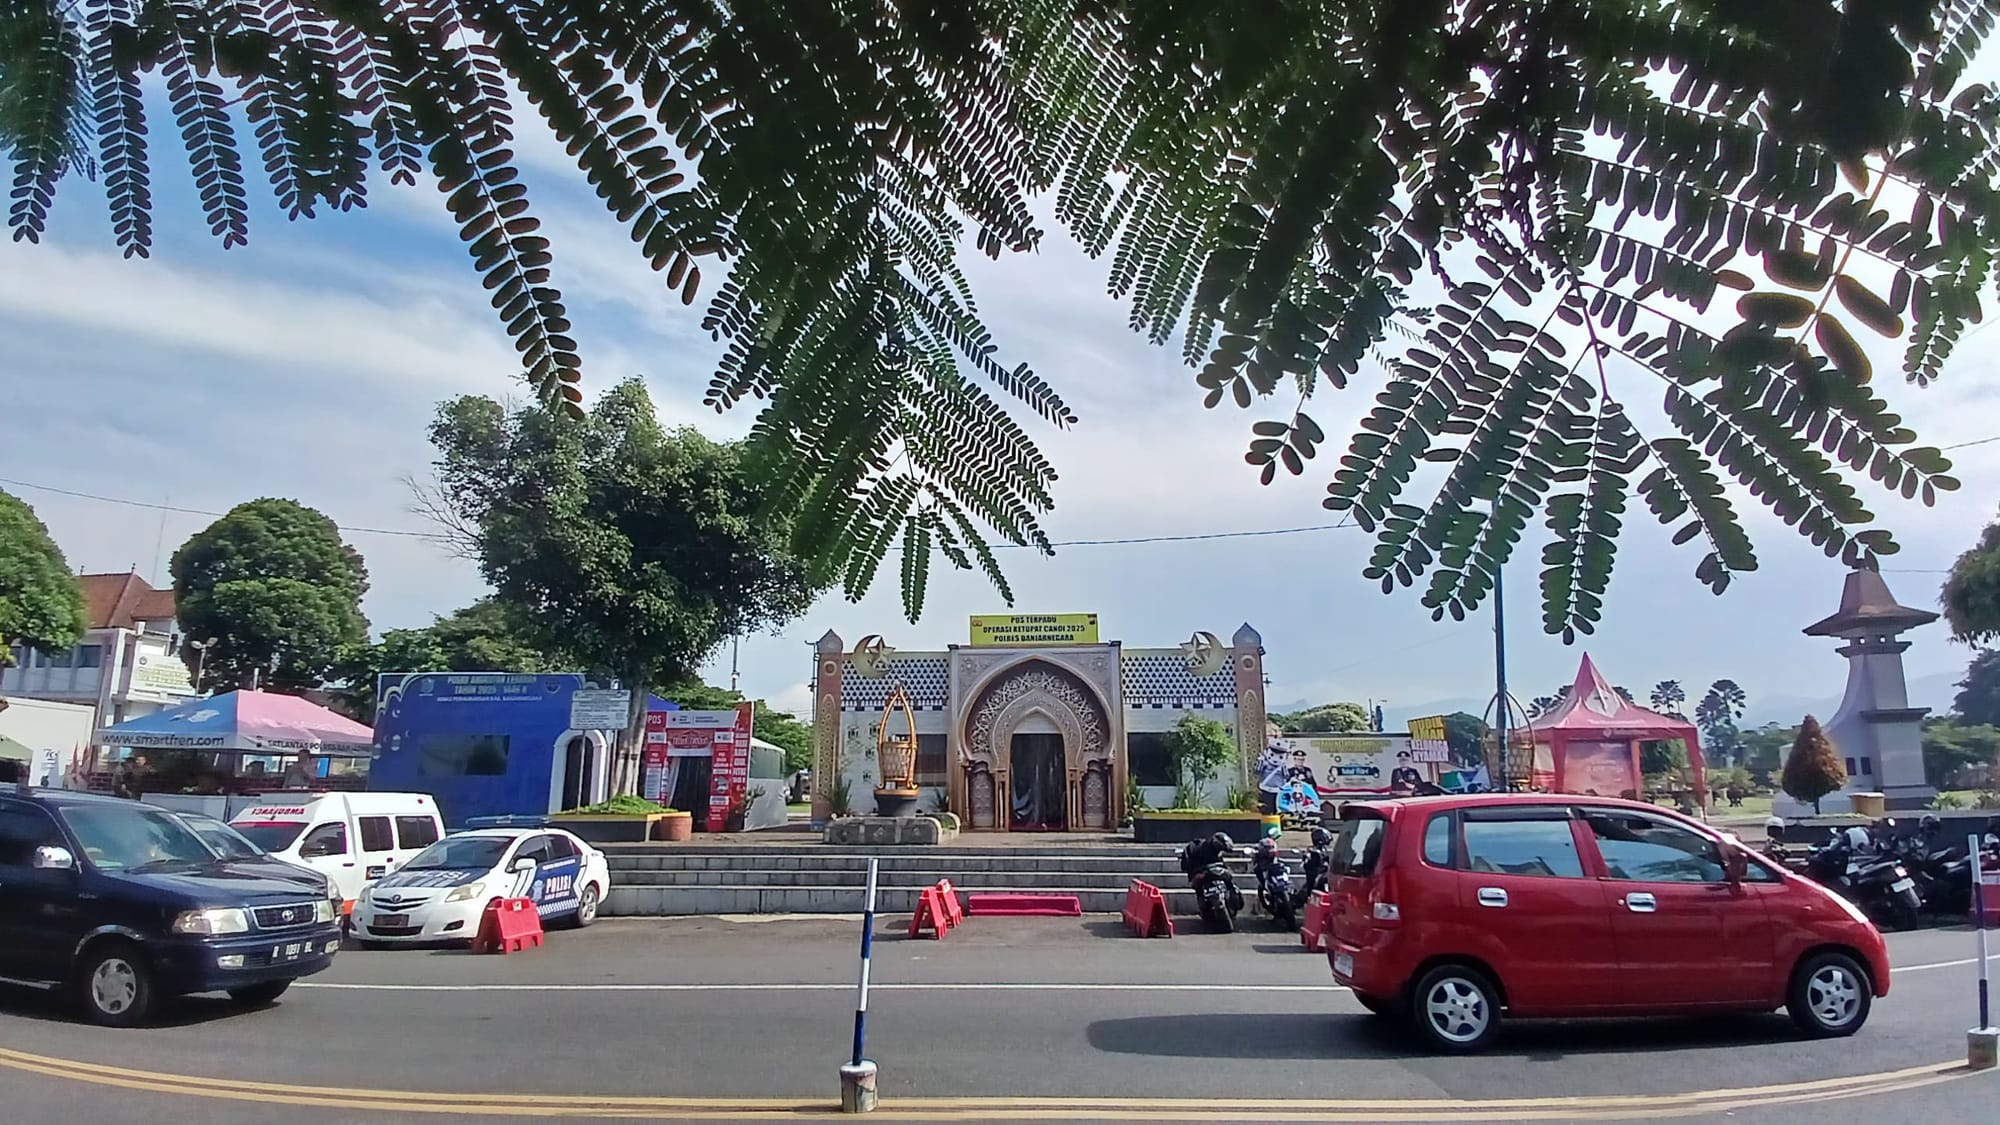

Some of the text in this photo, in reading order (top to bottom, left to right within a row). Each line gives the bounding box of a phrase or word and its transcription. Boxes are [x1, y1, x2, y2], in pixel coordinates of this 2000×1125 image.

[994, 634, 1074, 642] POLRES BANJARNEGARA
[648, 715, 662, 724] POS
[102, 734, 224, 747] www.smartfren.com
[545, 875, 571, 893] POLISI
